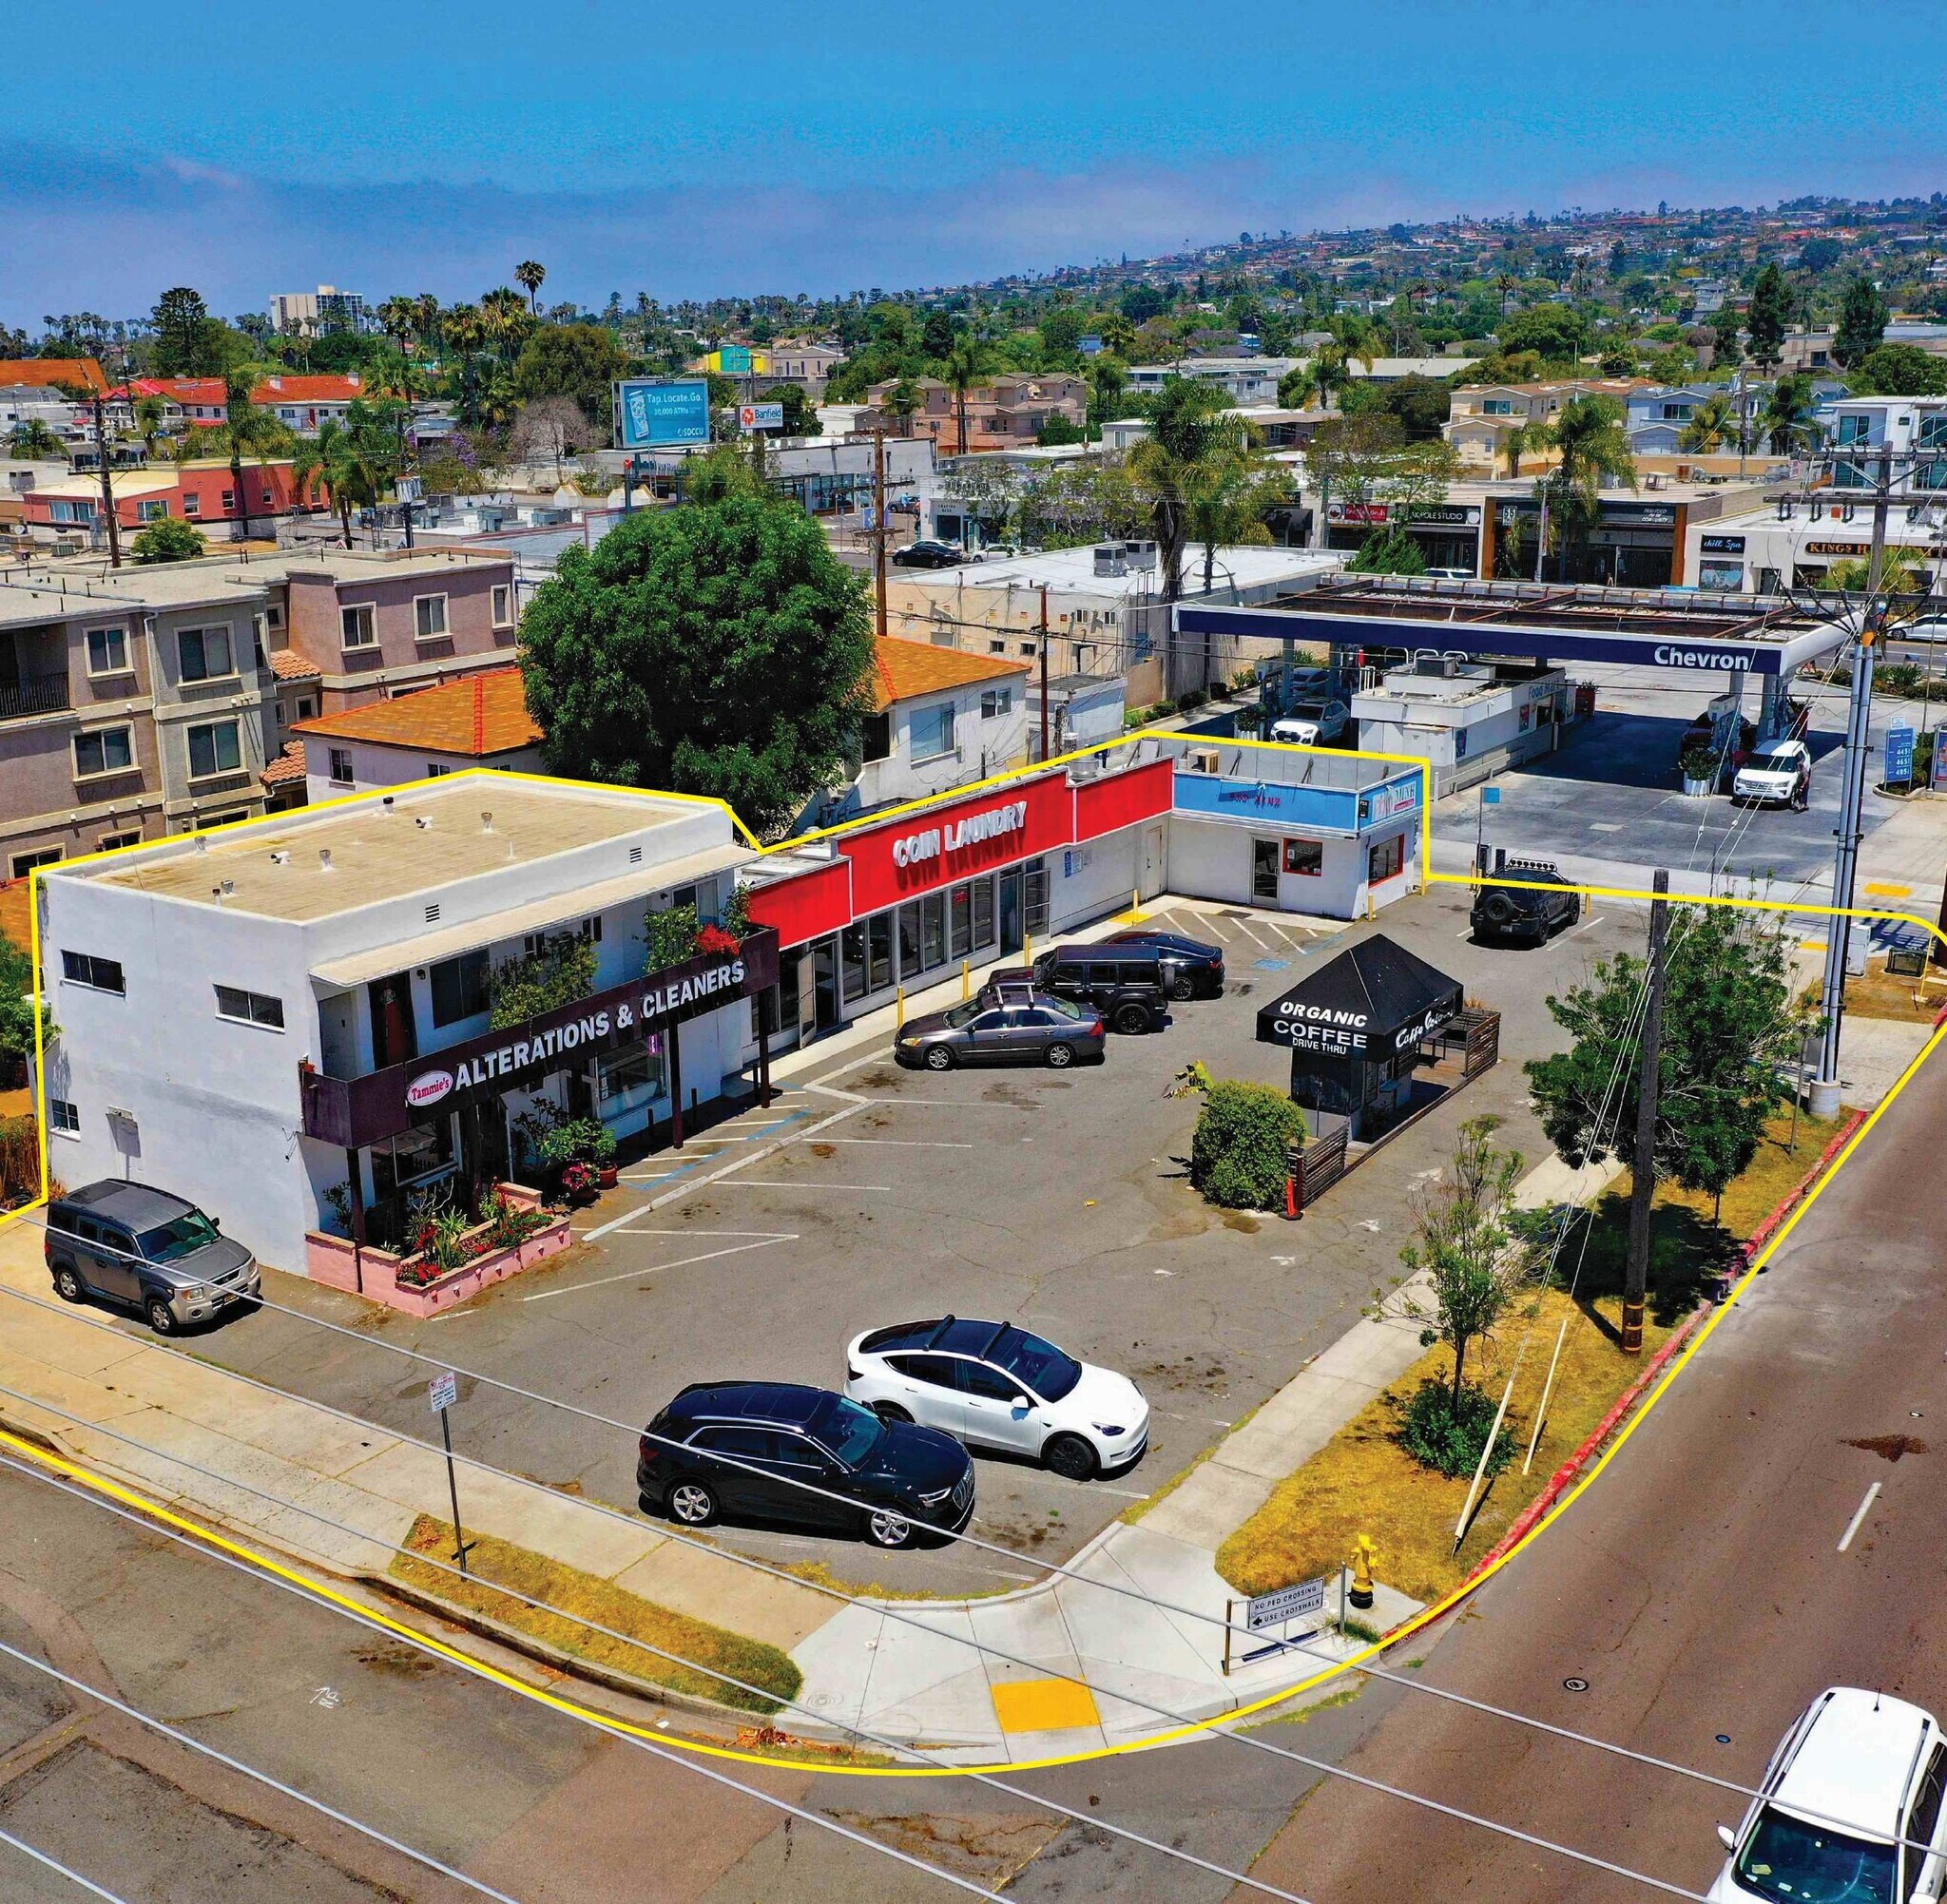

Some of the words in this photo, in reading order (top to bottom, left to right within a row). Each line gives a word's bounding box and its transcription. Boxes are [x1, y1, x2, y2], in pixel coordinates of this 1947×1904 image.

[755, 409, 781, 418] Banfield
[1725, 539, 1742, 551] Spa
[1809, 543, 1852, 553] KINGS
[1654, 645, 1749, 671] Chevron
[893, 828, 940, 868] COIN
[944, 800, 1027, 852] LAUNDRY
[1280, 1001, 1368, 1028] ORGANIC
[411, 1076, 451, 1102] Tammie's
[455, 1010, 610, 1091] ALTERATIONS
[616, 1003, 634, 1029] &
[641, 959, 745, 1019] CLEANERS
[1274, 1020, 1368, 1049] COFFEE
[1293, 1037, 1320, 1050] DRIVE
[1320, 1042, 1347, 1055] THRU
[1267, 1598, 1282, 1607] PED
[1283, 1586, 1317, 1603] CROSSING
[1264, 1612, 1279, 1623] USE
[1281, 1598, 1320, 1617] CROSSWALK
